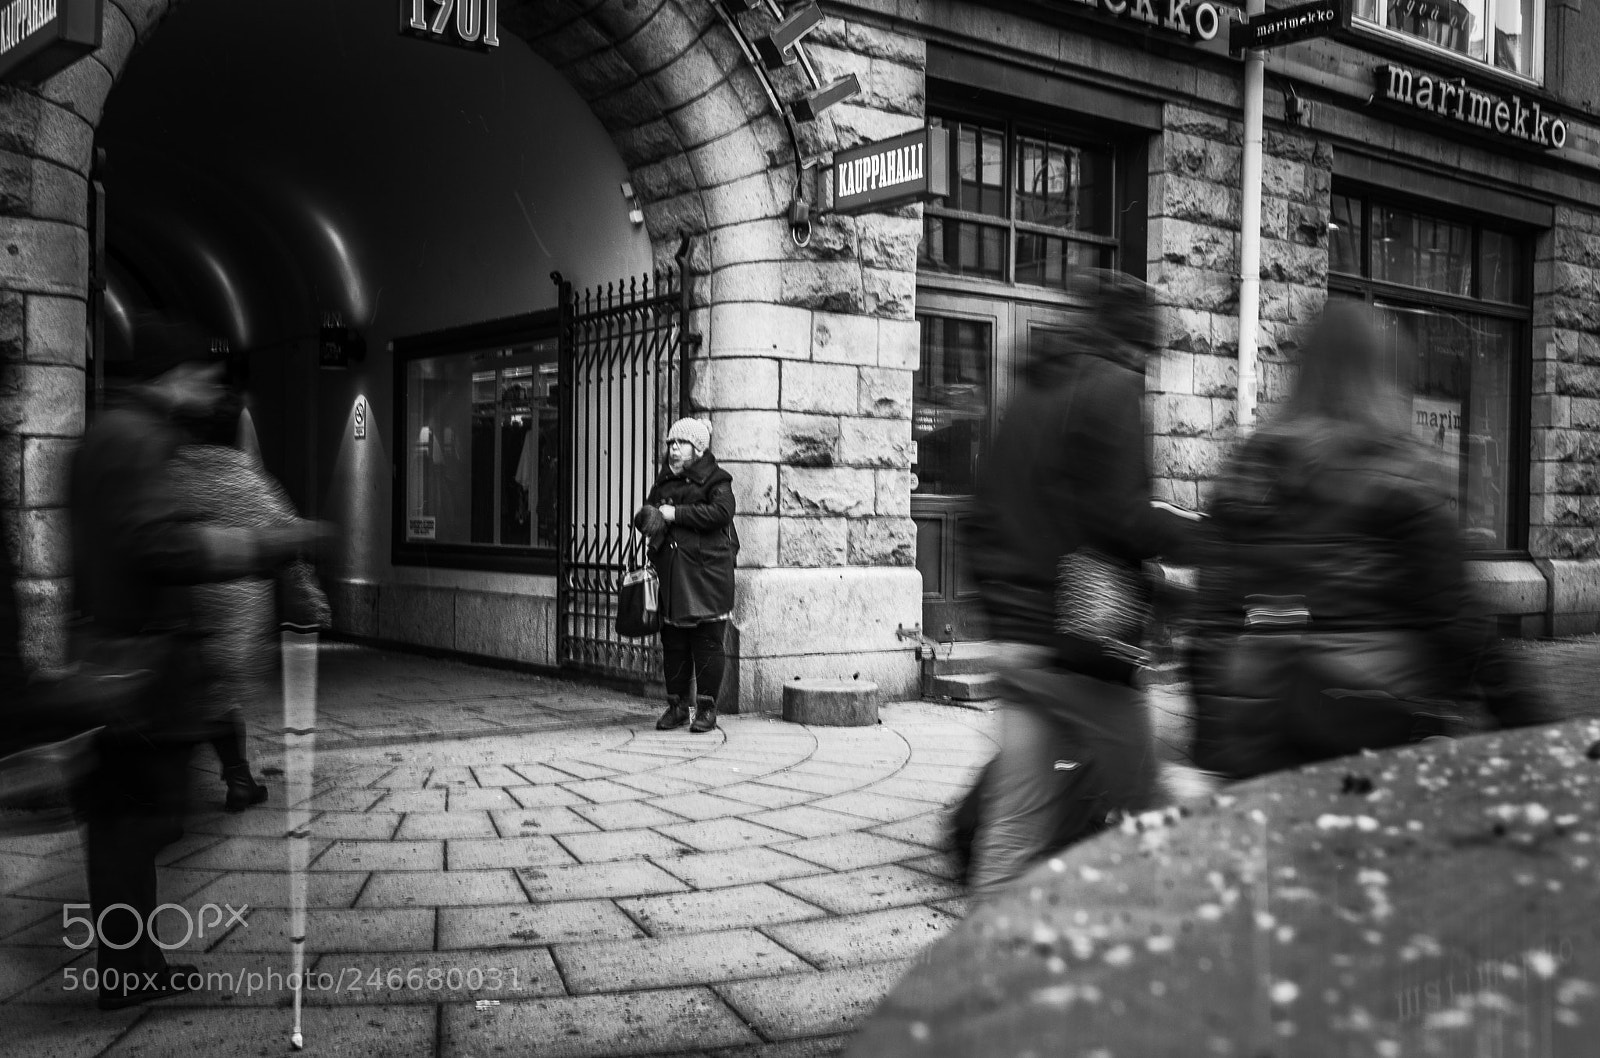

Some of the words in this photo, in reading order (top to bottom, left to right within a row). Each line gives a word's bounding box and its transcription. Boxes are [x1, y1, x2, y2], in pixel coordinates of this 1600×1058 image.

[1256, 8, 1335, 38] marimekko
[1387, 64, 1566, 149] marimekko
[838, 142, 924, 198] KAUPPAHALLI
